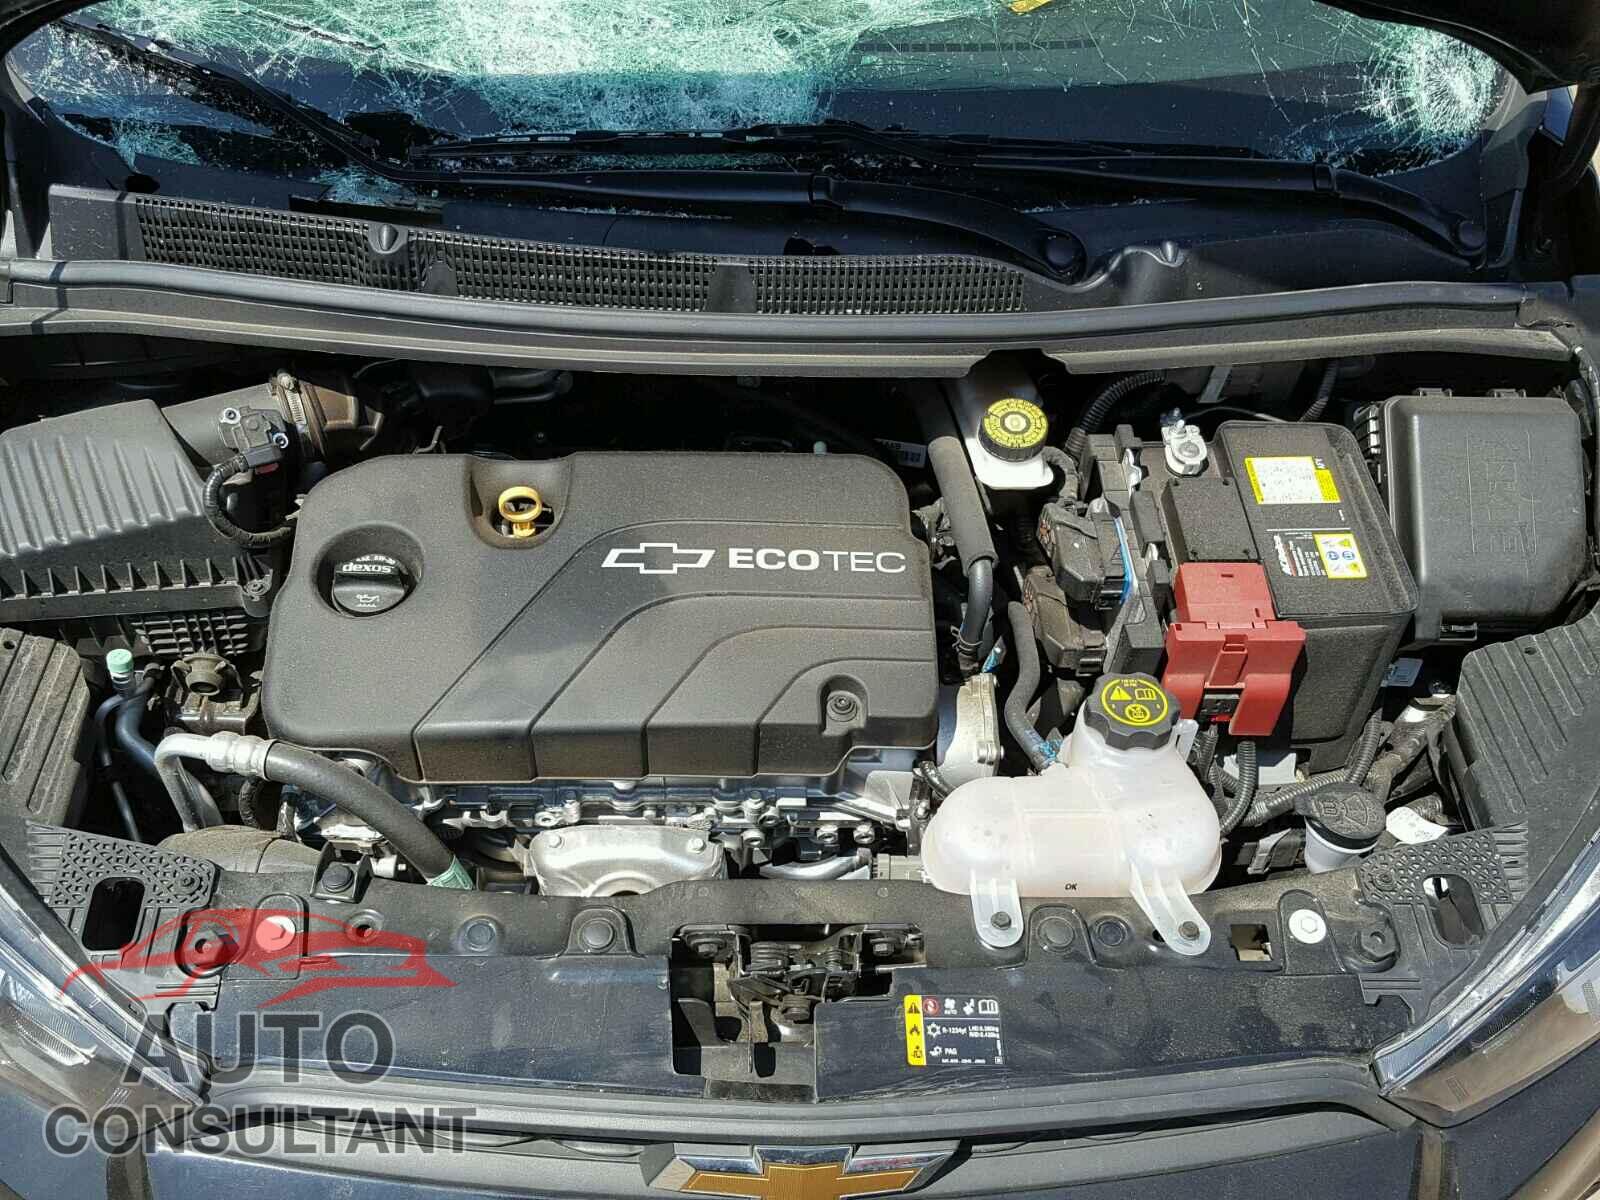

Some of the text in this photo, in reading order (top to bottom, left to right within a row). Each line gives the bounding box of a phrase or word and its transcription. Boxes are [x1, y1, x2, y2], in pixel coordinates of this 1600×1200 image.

[728, 547, 906, 573] ECOTEC
[342, 562, 391, 573] dexos
[944, 1047, 957, 1056] PAG
